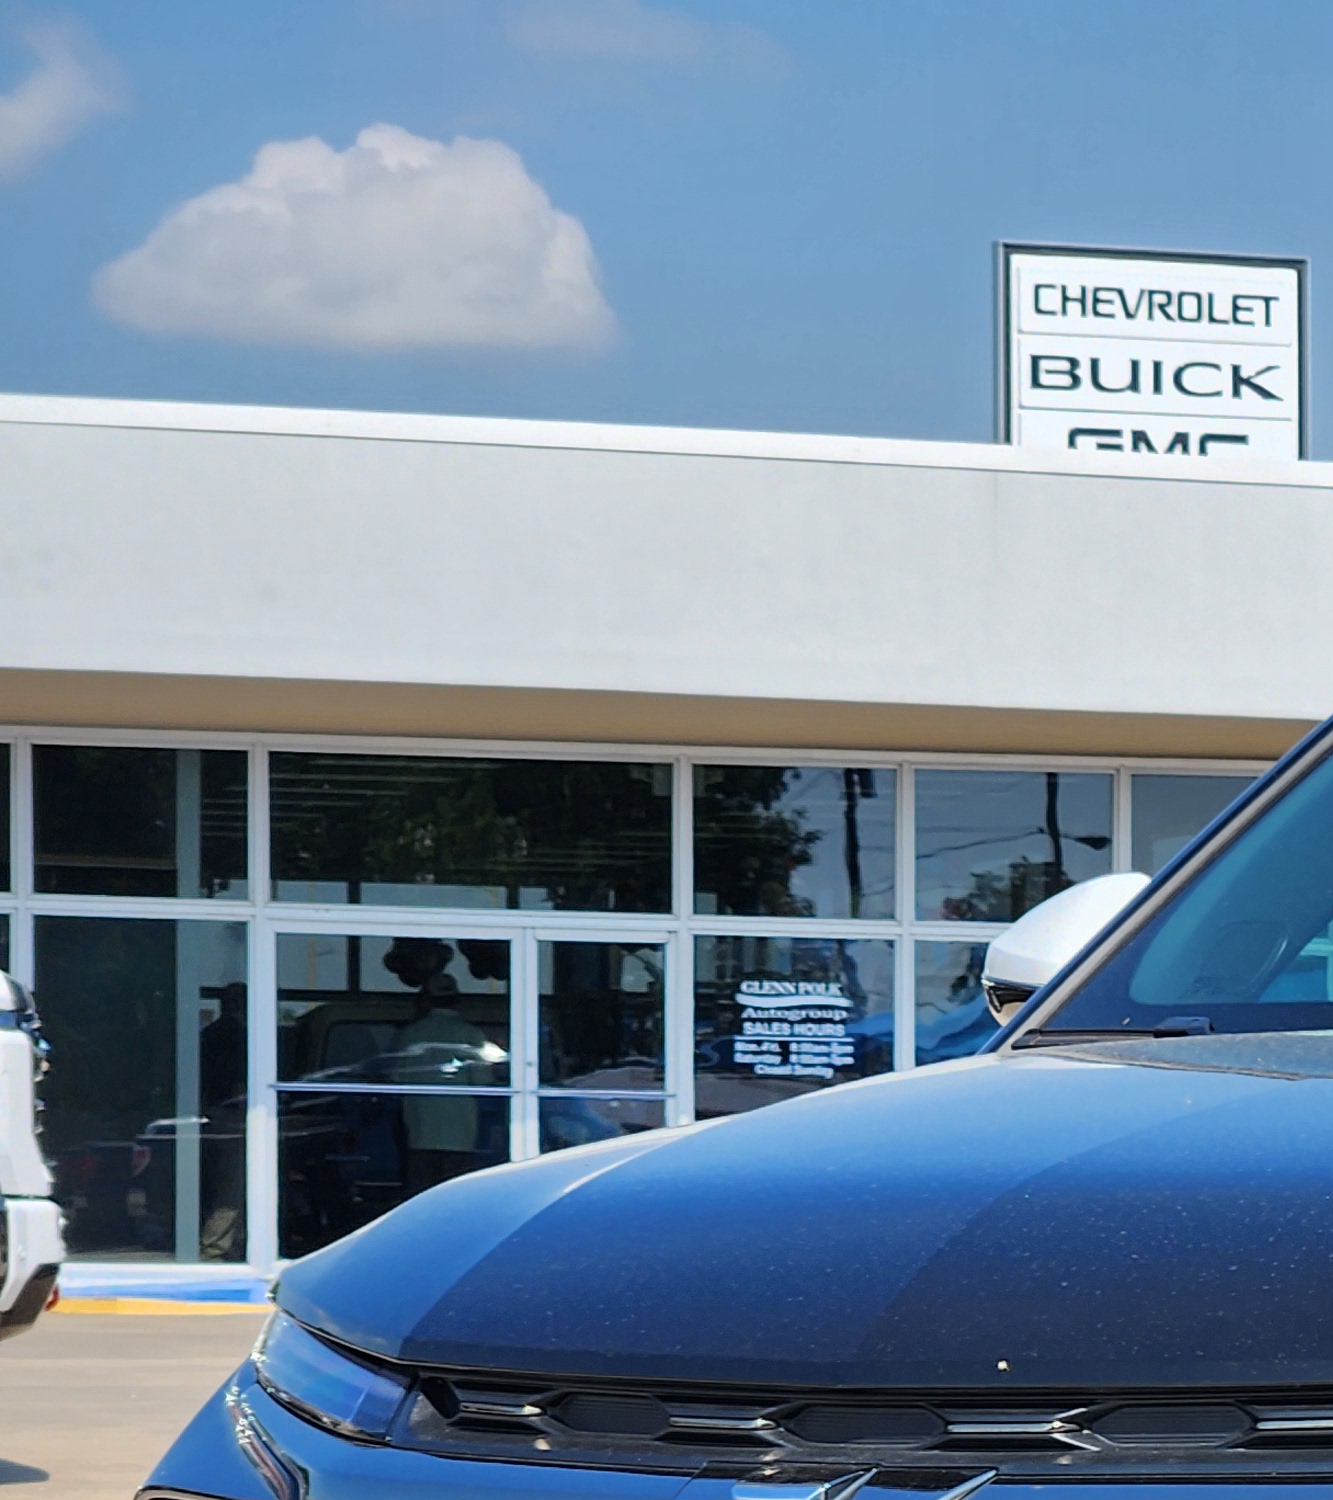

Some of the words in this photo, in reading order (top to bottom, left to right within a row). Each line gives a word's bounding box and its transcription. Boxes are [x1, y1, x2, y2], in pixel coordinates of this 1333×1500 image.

[1033, 283, 1280, 327] CHEVROLET
[1030, 354, 1284, 401] BUICK
[740, 980, 797, 995] GLENN
[798, 981, 844, 996] POLK
[741, 1008, 849, 1021] Autogroup
[743, 1021, 791, 1036] SALES
[793, 1023, 845, 1037] HOURS
